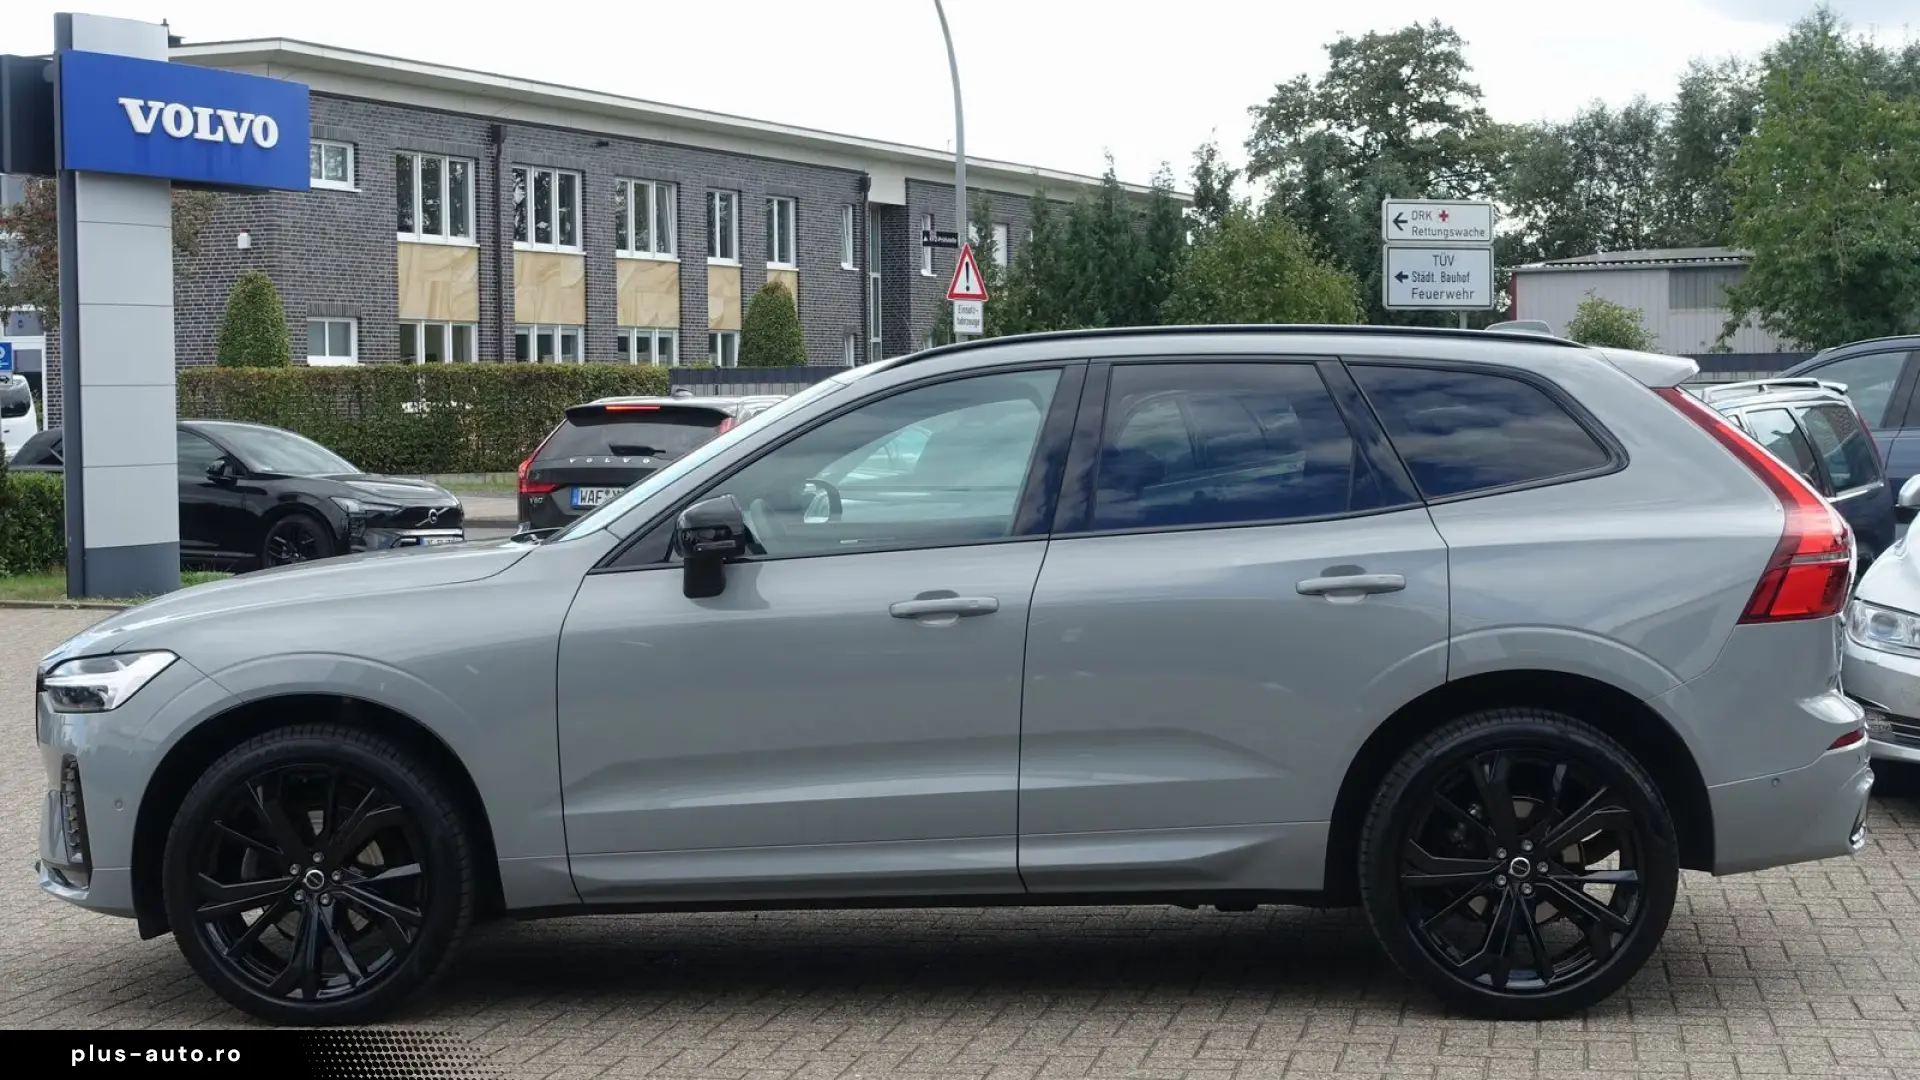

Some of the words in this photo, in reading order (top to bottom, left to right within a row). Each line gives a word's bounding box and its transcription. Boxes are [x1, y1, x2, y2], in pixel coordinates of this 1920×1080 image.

[118, 97, 279, 149] VOLVO
[1411, 210, 1433, 221] DRK
[1411, 225, 1486, 240] Rettungswache
[1432, 252, 1455, 267] TÜV
[1411, 270, 1437, 283] Städt.
[1440, 270, 1470, 283] Bauhof
[1411, 287, 1475, 300] Feuerwehr
